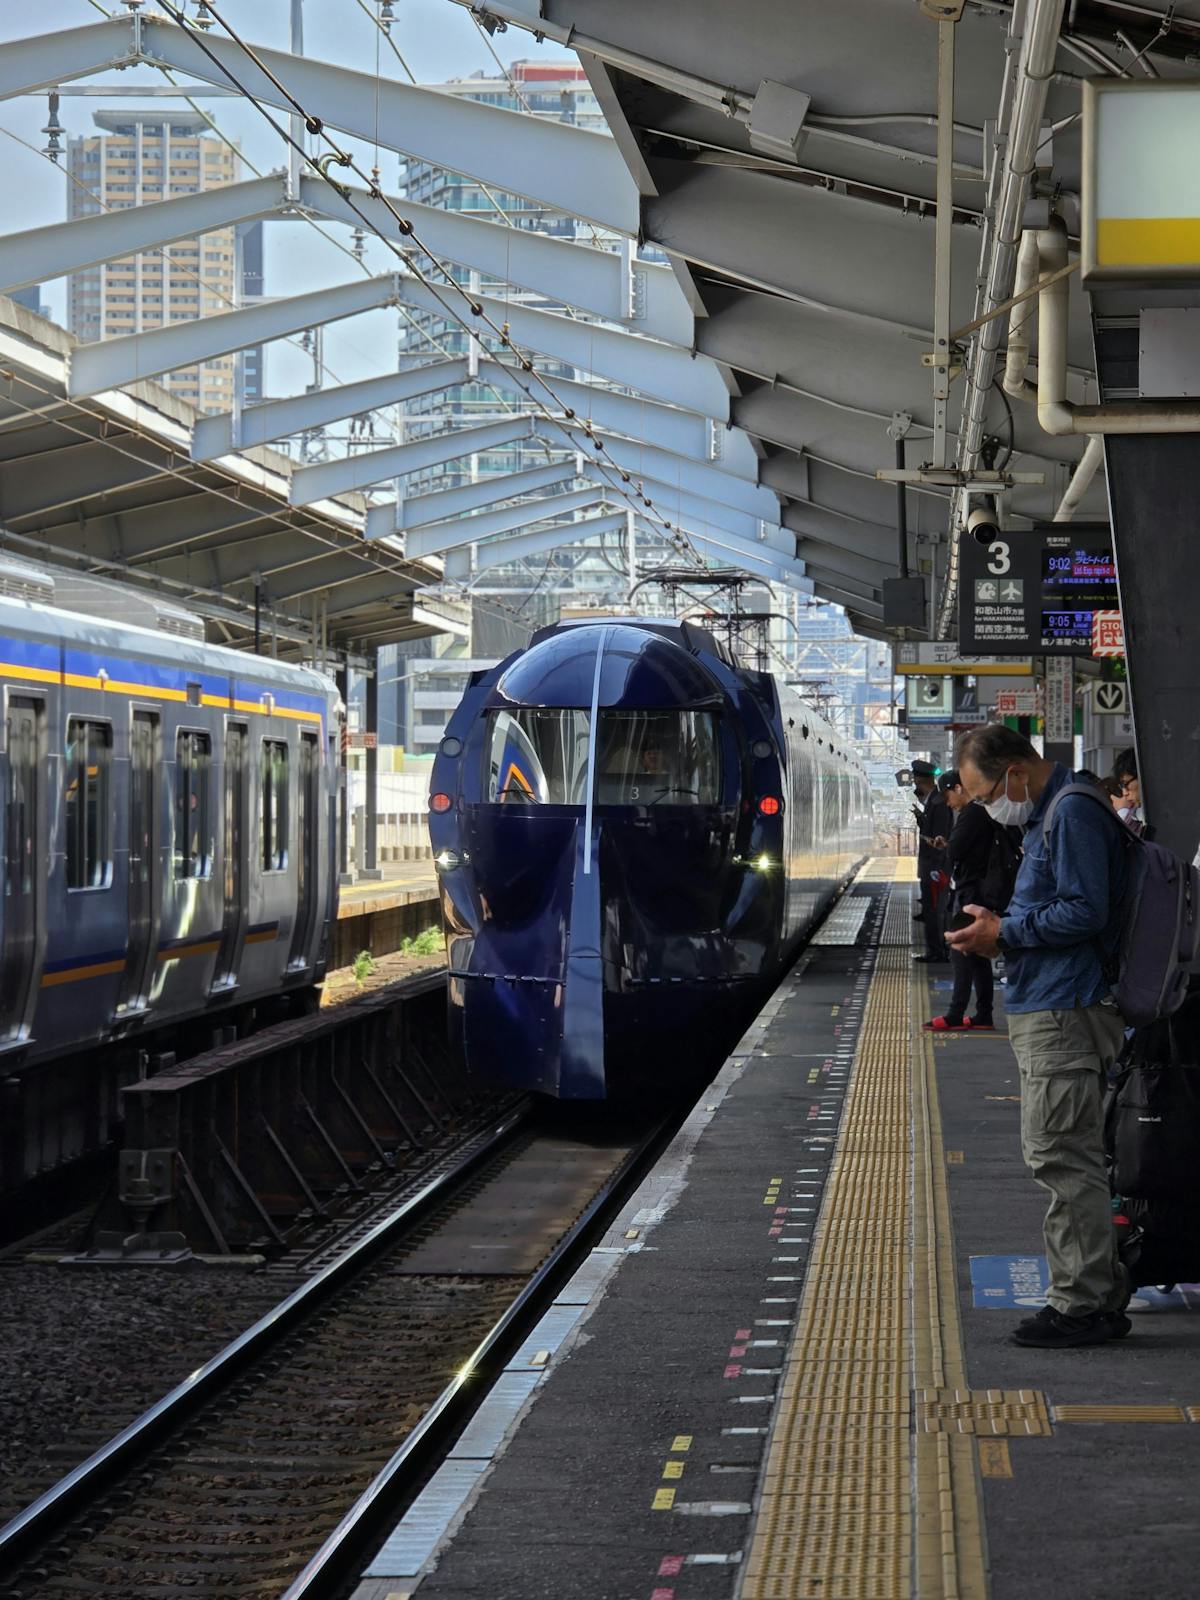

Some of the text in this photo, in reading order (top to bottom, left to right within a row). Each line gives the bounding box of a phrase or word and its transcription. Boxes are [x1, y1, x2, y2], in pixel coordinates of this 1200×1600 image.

[987, 541, 1010, 574] 3
[1049, 557, 1071, 570] 9:02
[975, 606, 1025, 615] 和歌山市方面
[1048, 616, 1070, 627] 9:05
[975, 624, 1025, 634] 関西空港方面
[631, 786, 640, 800] 3
